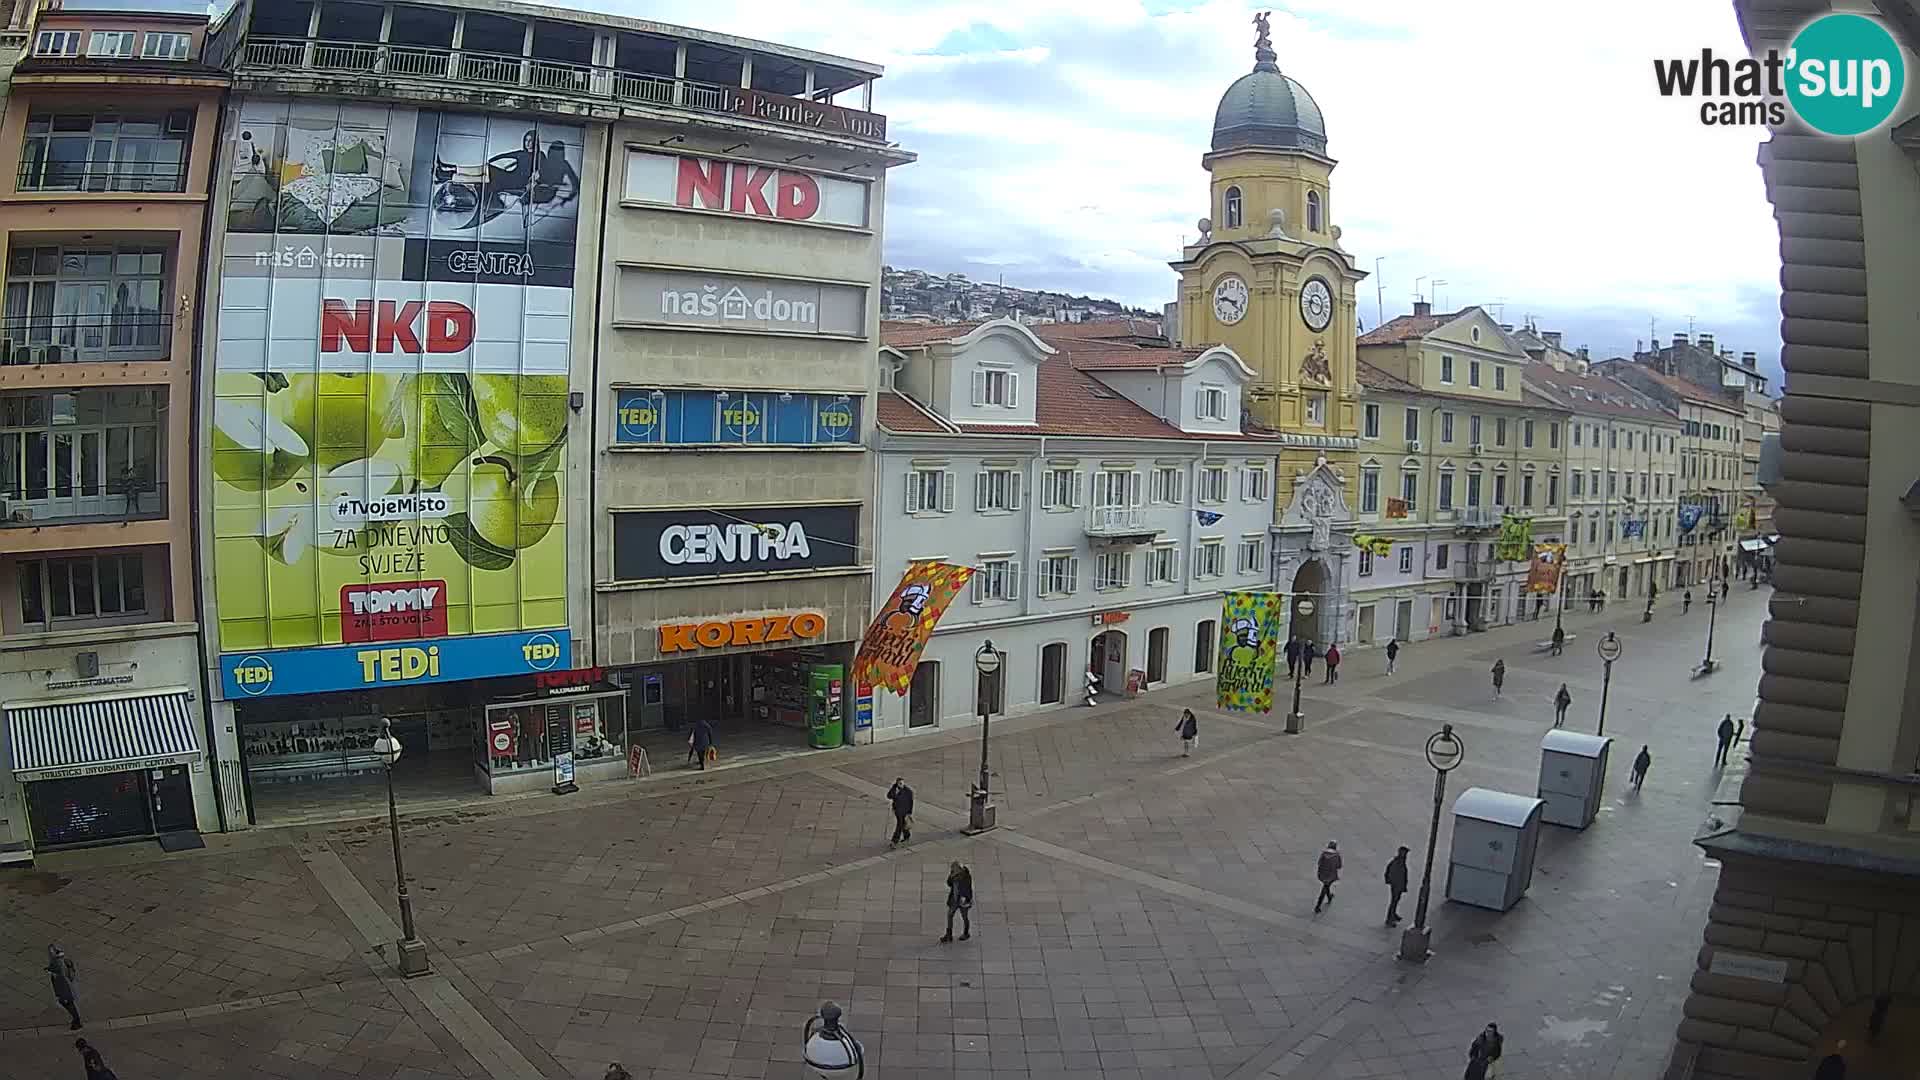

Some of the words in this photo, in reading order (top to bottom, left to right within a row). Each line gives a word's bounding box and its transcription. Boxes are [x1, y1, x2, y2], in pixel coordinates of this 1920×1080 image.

[723, 88, 745, 112] Le
[675, 157, 821, 220] NKD
[449, 250, 534, 276] CENTRA
[661, 284, 717, 316] naš
[754, 290, 816, 323] dom
[320, 297, 478, 354] NKD
[618, 408, 657, 425] TEDi
[723, 409, 760, 426] TEDi
[820, 411, 852, 427] TEDi
[338, 496, 446, 517] #TvojeMisto
[334, 528, 358, 549] ZA
[366, 524, 450, 548] DNEVNO
[659, 521, 810, 564] CENTRA
[359, 548, 426, 575] SVJEŽE
[348, 586, 440, 615] TOMMY
[379, 614, 399, 626] ŠTO
[659, 613, 826, 653] KORZO
[357, 646, 440, 683] TEDi
[522, 643, 560, 661] TEDi
[233, 665, 273, 685] TEDi
[144, 757, 176, 768] CENTAR
